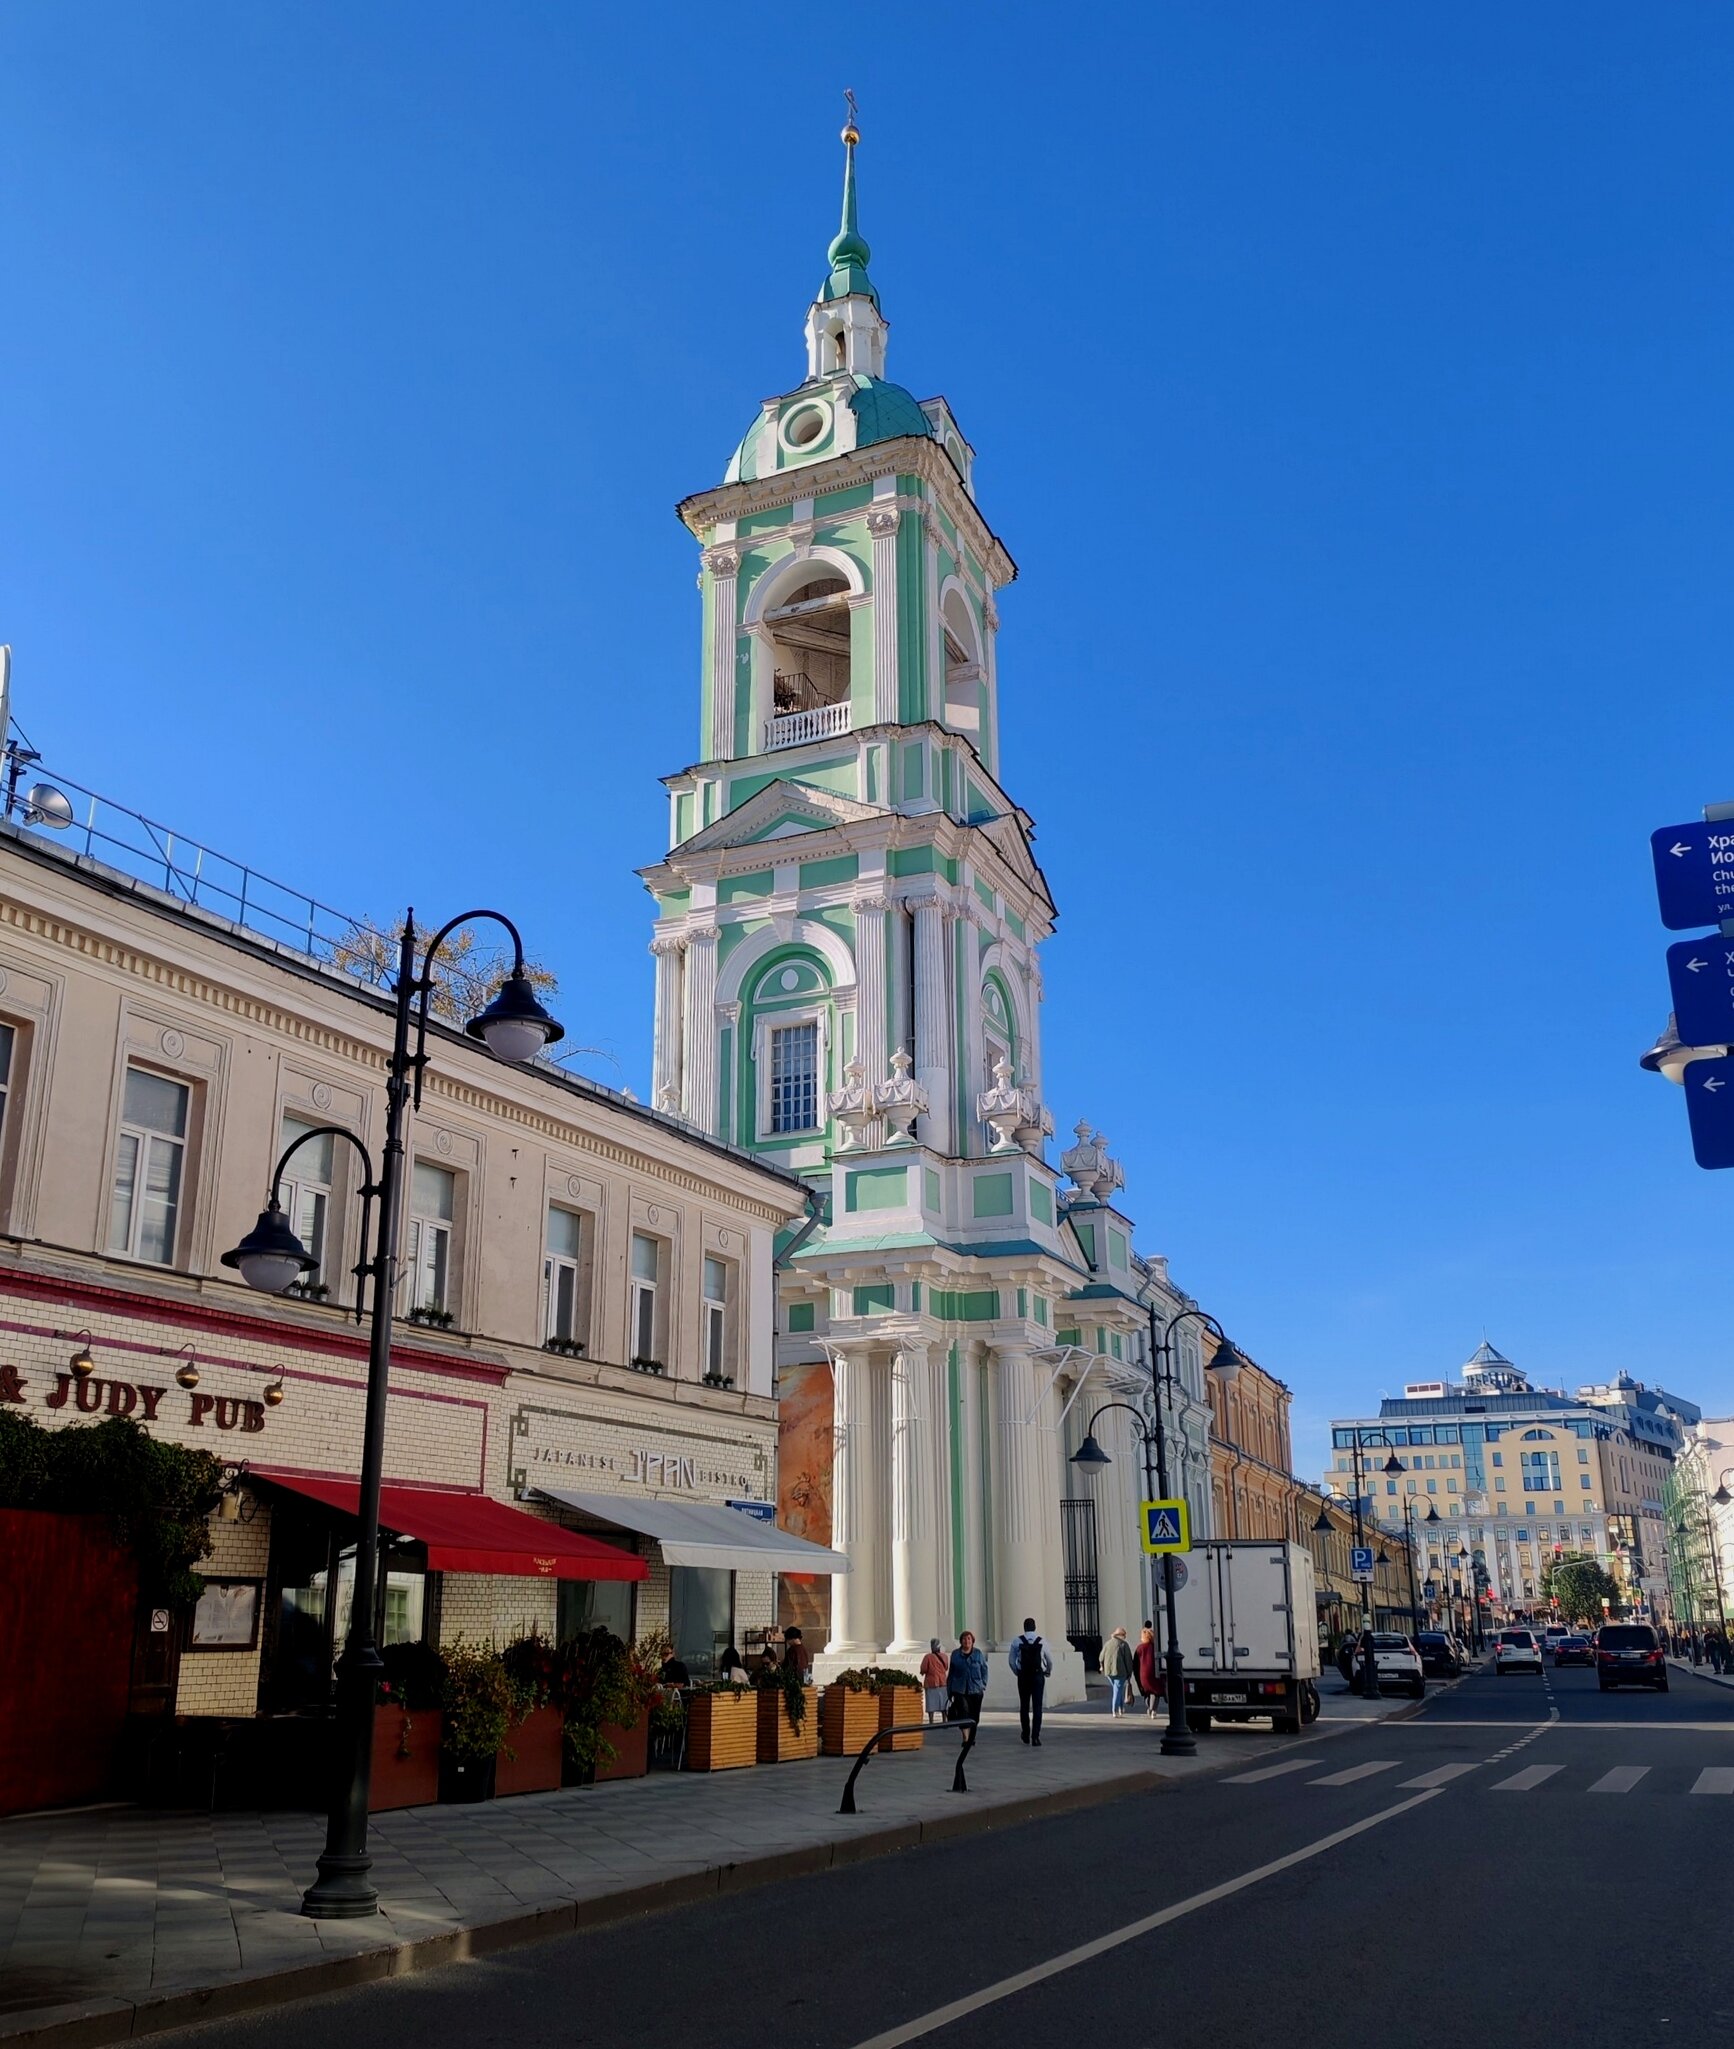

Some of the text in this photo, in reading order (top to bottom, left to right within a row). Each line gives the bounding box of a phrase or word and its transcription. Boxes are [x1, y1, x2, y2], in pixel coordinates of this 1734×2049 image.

[0, 1364, 266, 1433] & JUDY PUB
[699, 1470, 748, 1487] BISTRO
